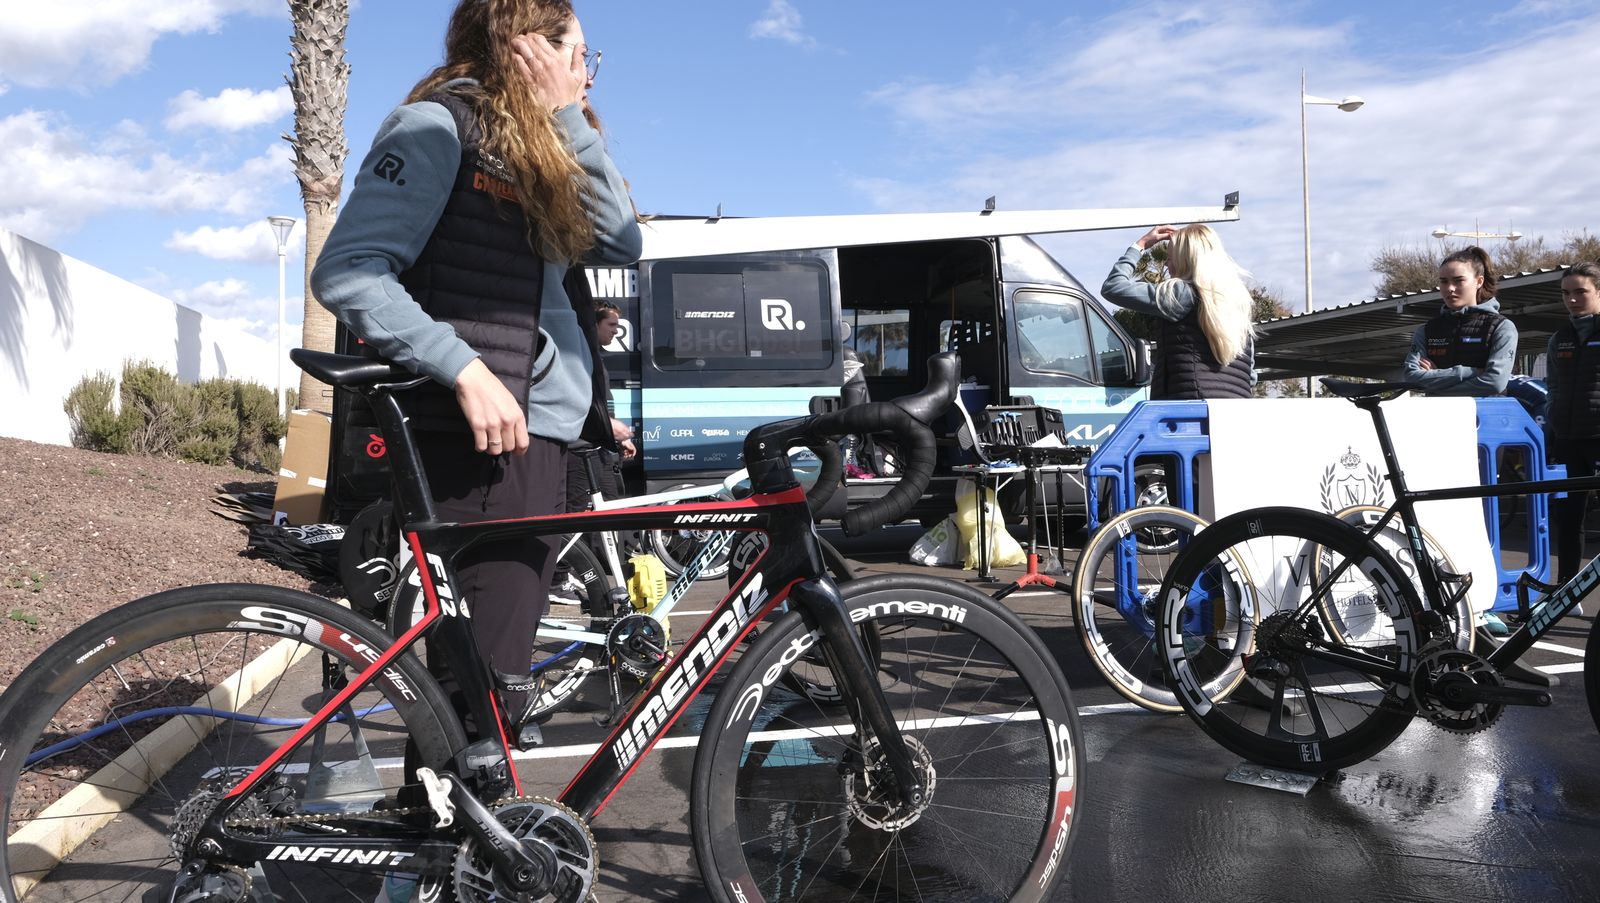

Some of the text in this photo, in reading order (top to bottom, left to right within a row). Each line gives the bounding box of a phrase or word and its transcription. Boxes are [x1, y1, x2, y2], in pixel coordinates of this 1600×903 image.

[670, 453, 695, 461] KMC
[673, 513, 758, 524] INFINIT
[426, 552, 457, 618] F12
[849, 600, 967, 624] ementi
[76, 641, 107, 665] ceramic
[266, 844, 415, 866] INFINIT
